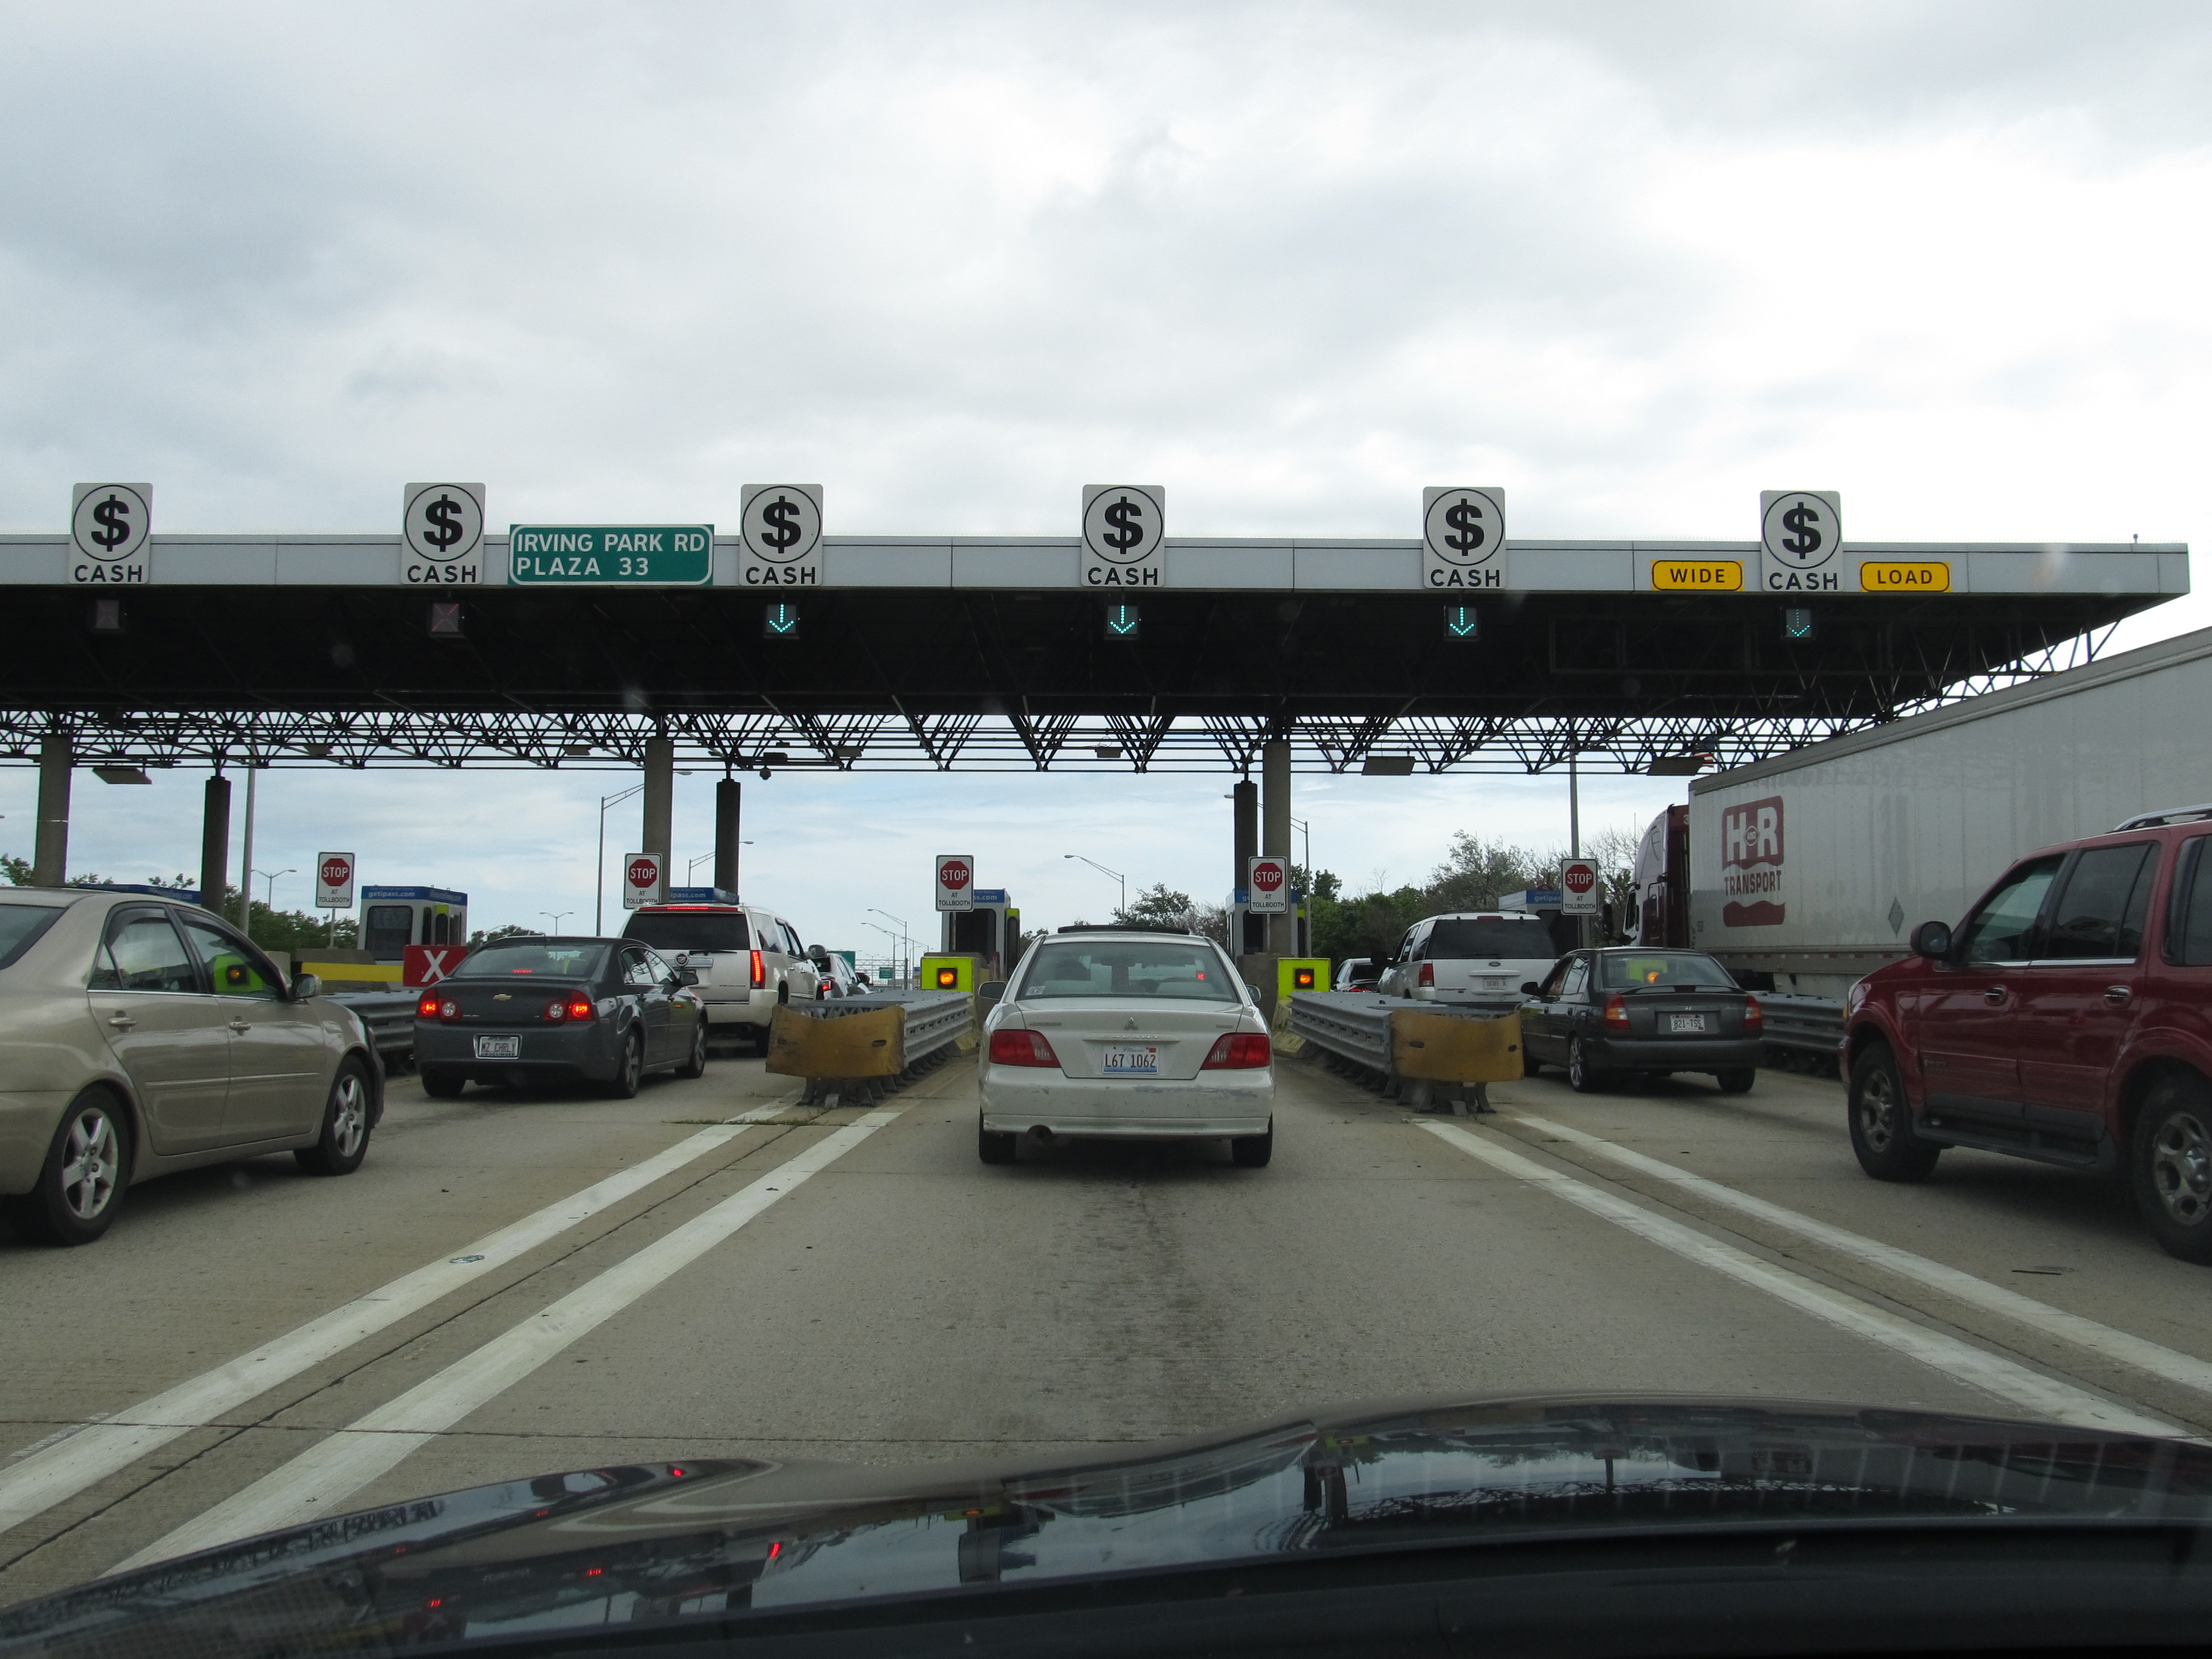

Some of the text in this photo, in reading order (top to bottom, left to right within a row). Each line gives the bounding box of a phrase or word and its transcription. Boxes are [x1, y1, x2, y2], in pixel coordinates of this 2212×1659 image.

[517, 534, 705, 552] IRVING PARK RD
[74, 565, 142, 582] CASH
[407, 565, 477, 583] CASH
[517, 557, 649, 576] PLAZA 33
[745, 567, 816, 585] CASH
[1088, 567, 1158, 586] CASH
[1430, 569, 1500, 587] CASH
[1670, 568, 1726, 583] WIDE
[1769, 572, 1838, 590] CASH
[1877, 570, 1933, 585] LOAD
[322, 867, 349, 878] STOP
[630, 868, 656, 879] STOP
[942, 870, 968, 881] STOP
[1255, 872, 1281, 883] STOP
[1567, 873, 1593, 884] STOP
[1724, 870, 1782, 896] TRANSPORT
[1105, 1053, 1156, 1068] L67 1062
